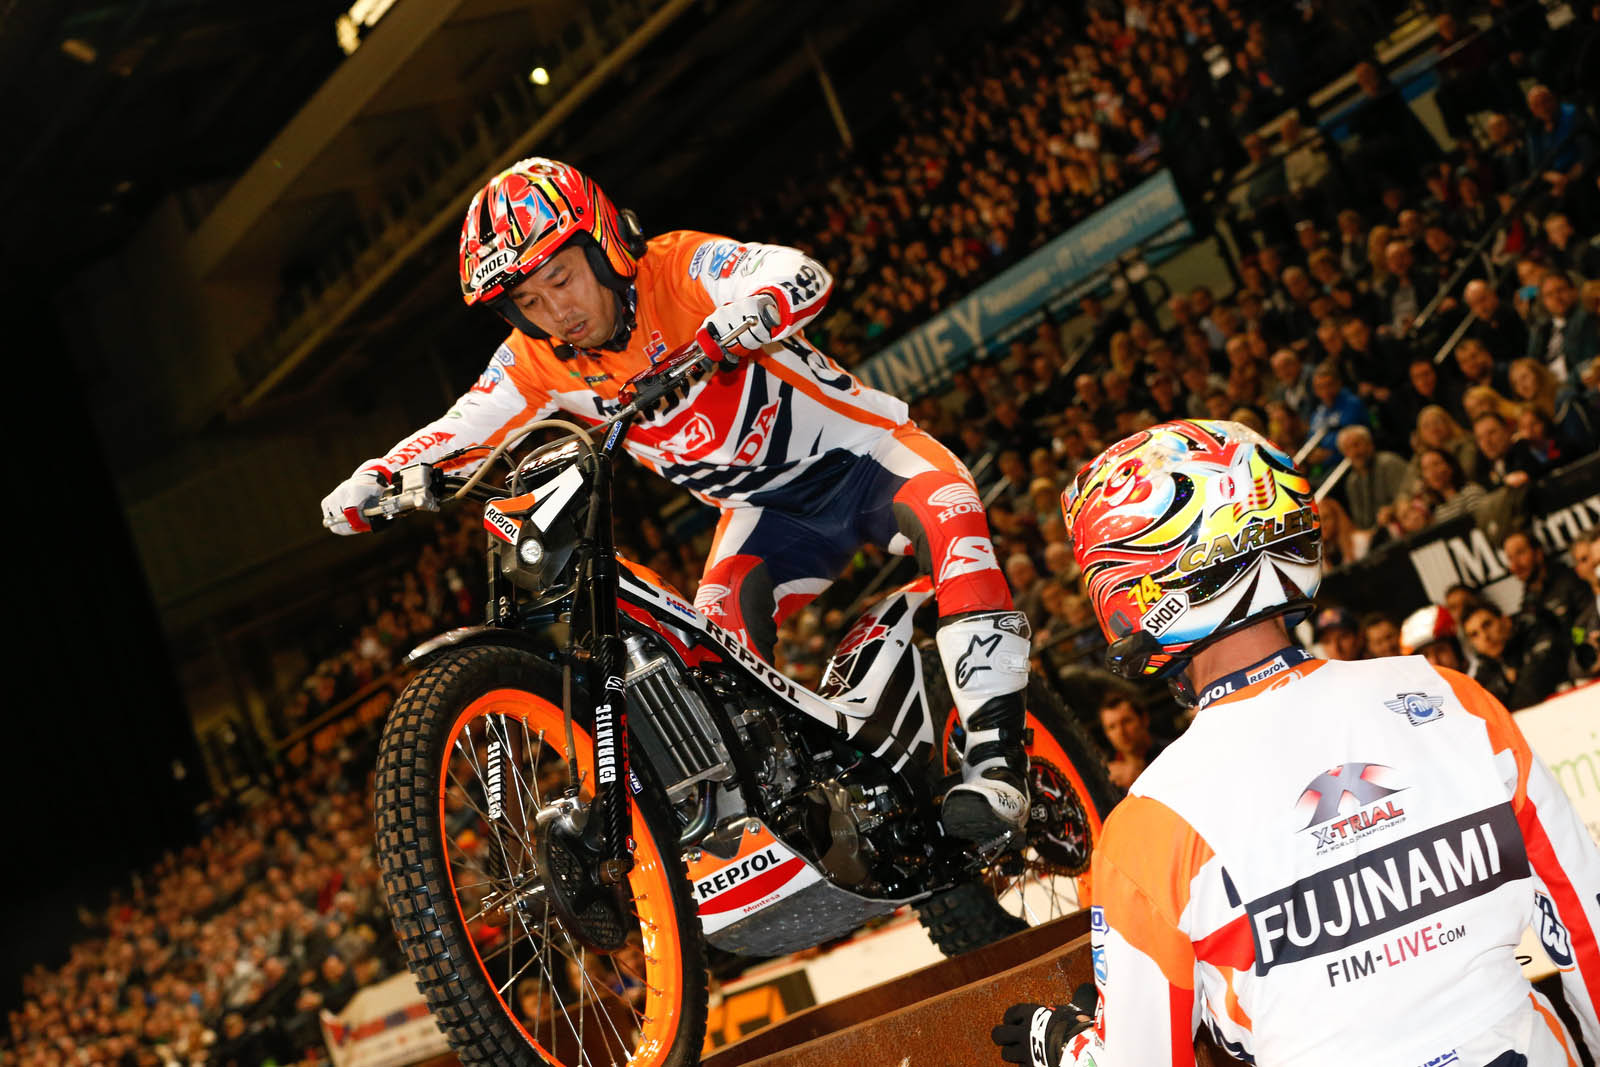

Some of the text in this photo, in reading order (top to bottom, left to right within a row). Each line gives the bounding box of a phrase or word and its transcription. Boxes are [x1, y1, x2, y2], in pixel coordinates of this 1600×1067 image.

[476, 253, 509, 283] SHOEI
[486, 508, 518, 538] REPSOL
[666, 597, 697, 620] HRC
[1145, 597, 1184, 634] SHOEI
[705, 619, 800, 704] REPSOL
[1250, 661, 1286, 683] REPSOL
[697, 849, 781, 899] REPSOL
[743, 893, 781, 914] Montesa
[1253, 823, 1501, 964] FUJINAMI
